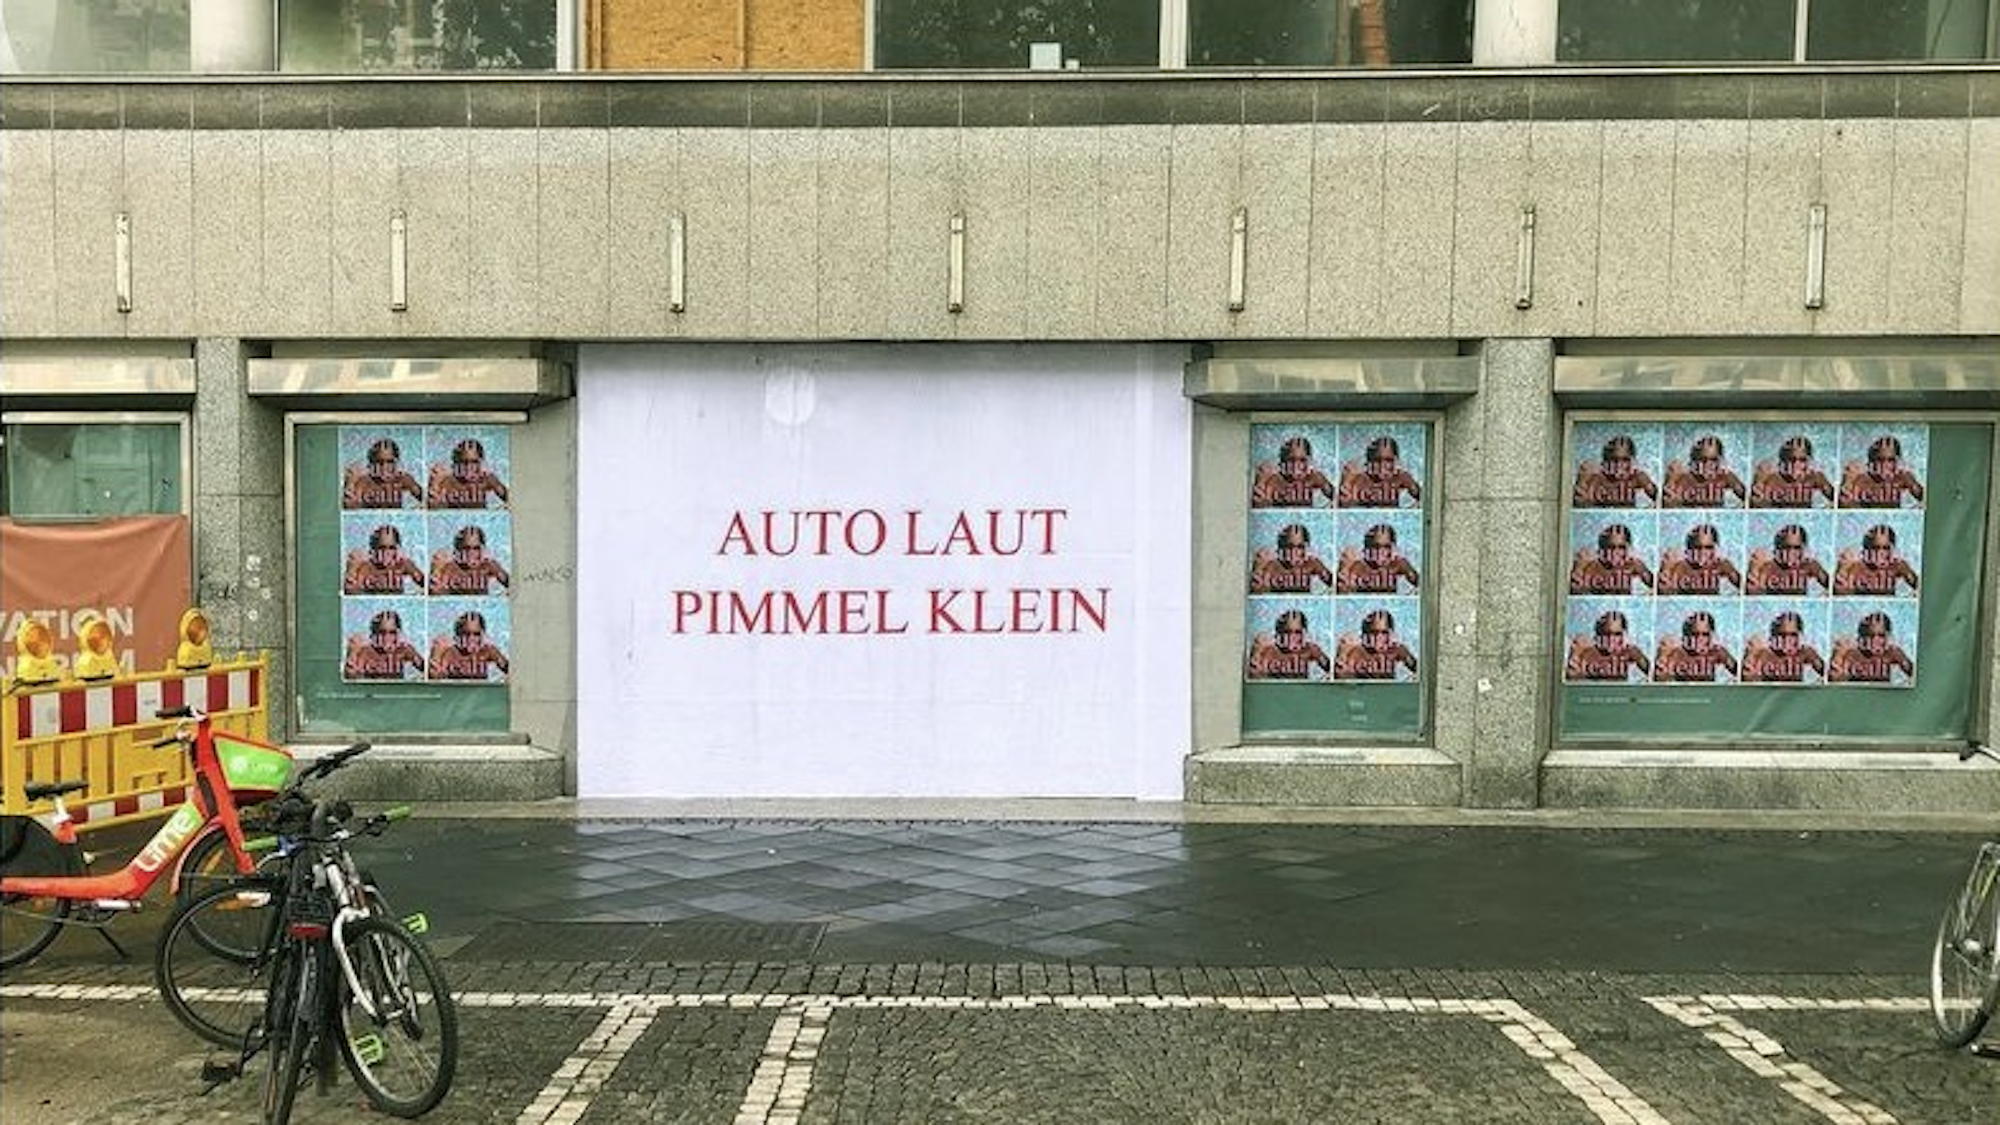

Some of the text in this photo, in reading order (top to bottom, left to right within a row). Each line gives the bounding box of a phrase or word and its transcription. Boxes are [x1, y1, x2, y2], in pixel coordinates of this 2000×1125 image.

[716, 509, 1067, 556] AUTO LAUT
[671, 587, 1110, 635] PIMMEL KLEIN
